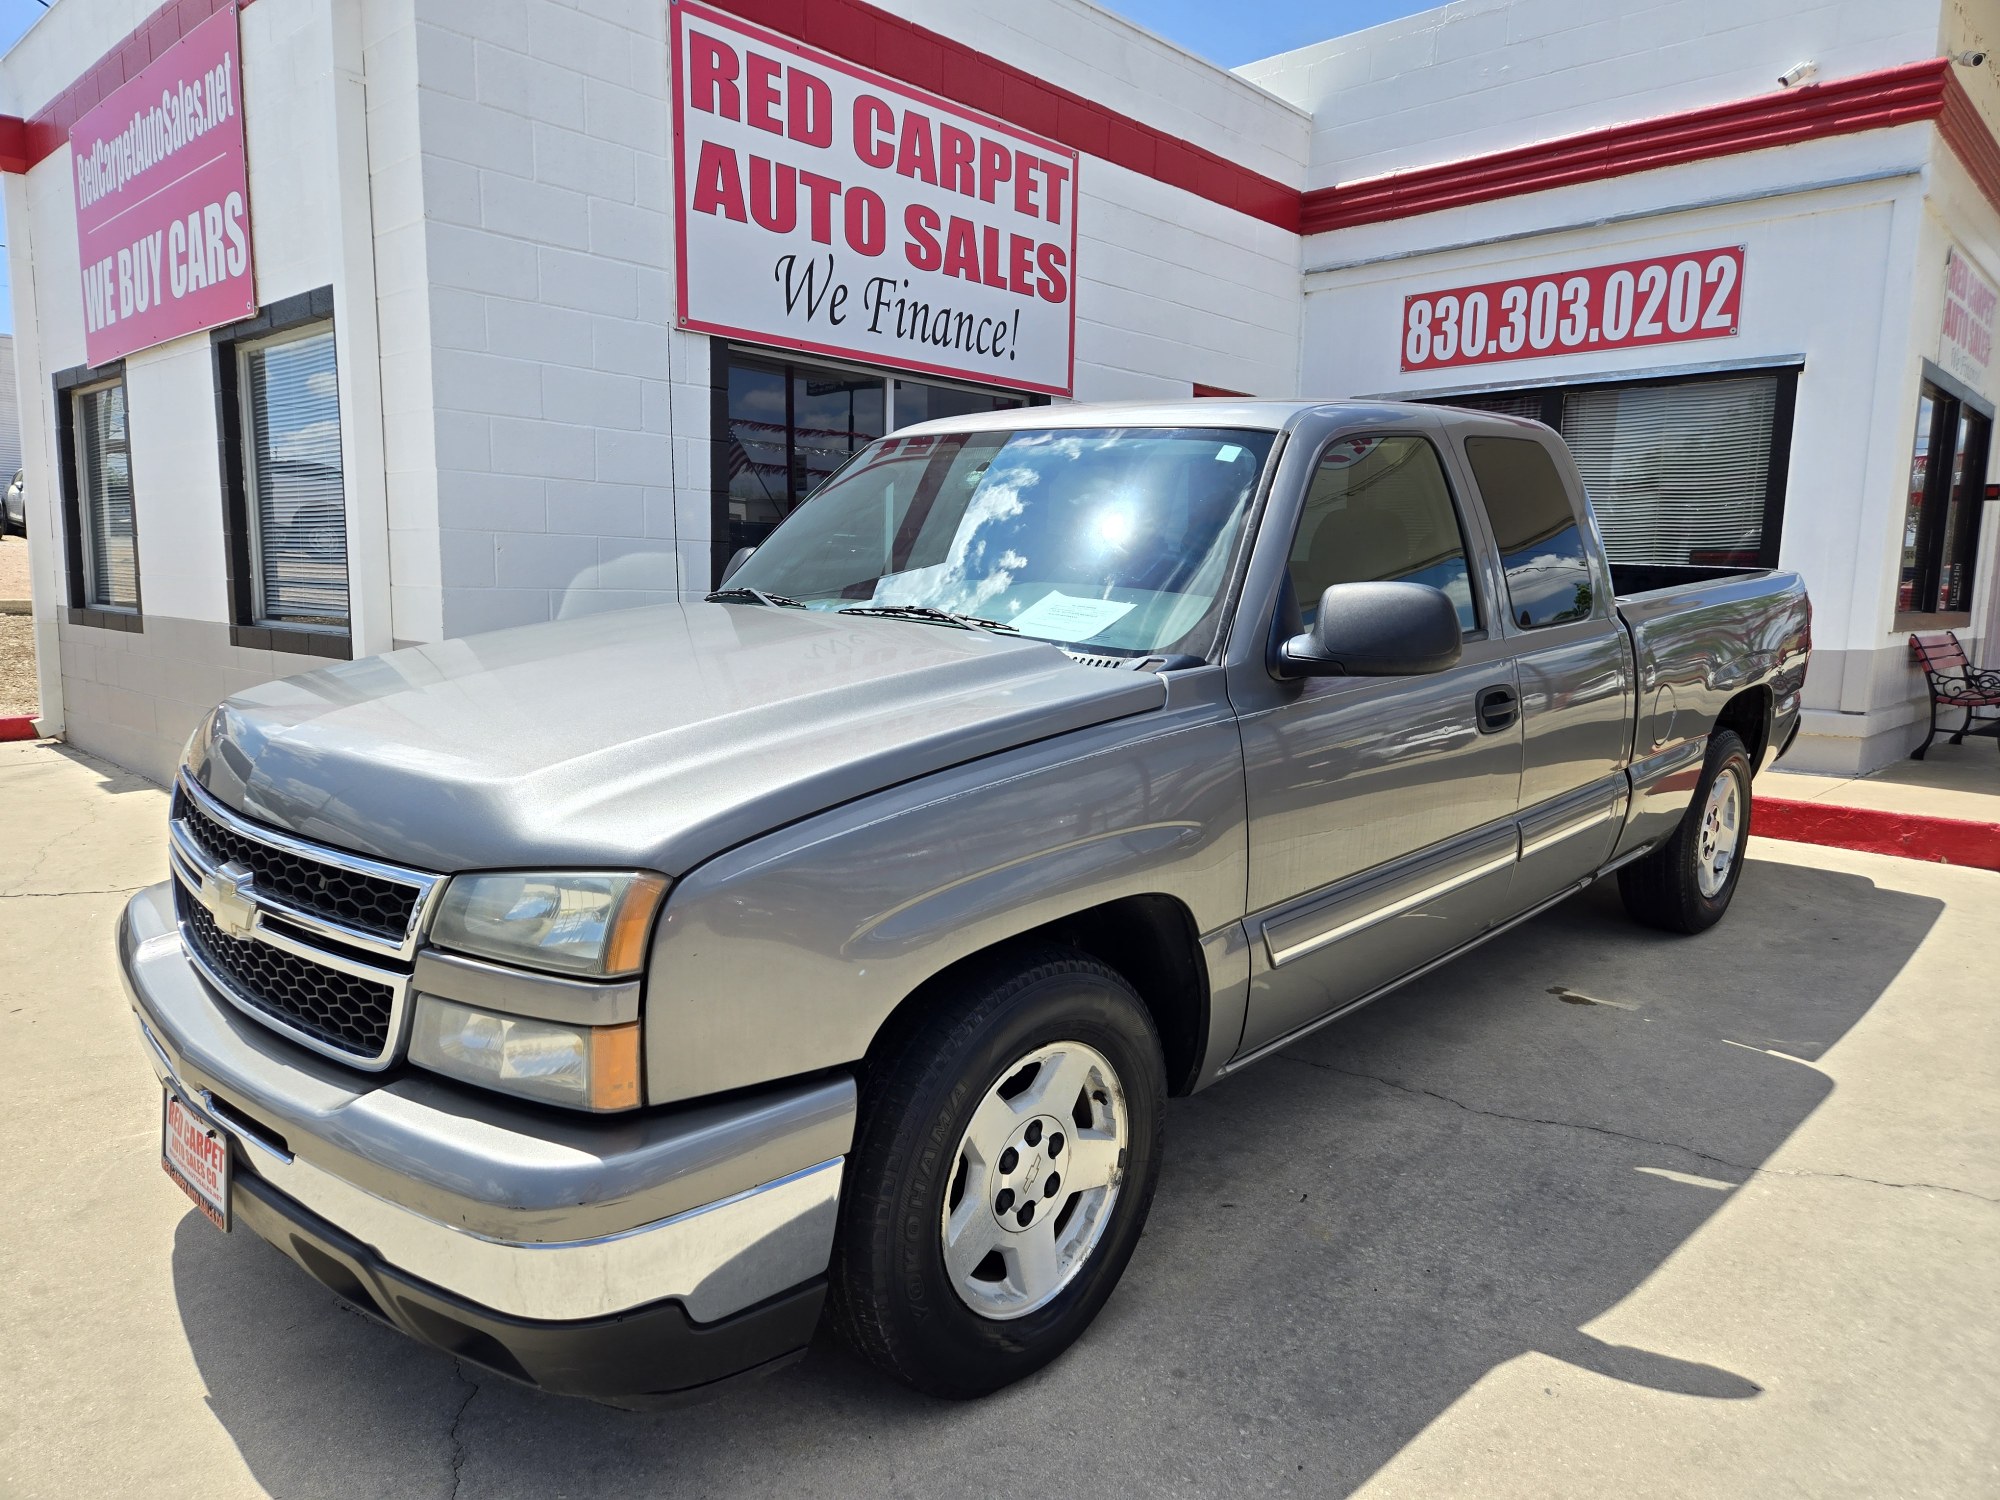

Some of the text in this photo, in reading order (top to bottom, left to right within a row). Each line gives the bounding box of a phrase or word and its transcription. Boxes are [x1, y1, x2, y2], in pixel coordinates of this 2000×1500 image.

[76, 51, 234, 210] RedCarpetAutoSales.net
[689, 29, 1069, 225] RED CARPET
[82, 191, 246, 333] WE BUY CARS
[692, 140, 1068, 304] AUTO SALES
[774, 253, 1020, 361] We Finance!
[1405, 255, 1738, 364] 830.303.0202
[168, 1100, 183, 1138] RED
[184, 1125, 224, 1174] CARPET
[171, 1133, 219, 1191] AUTO SALES CO.
